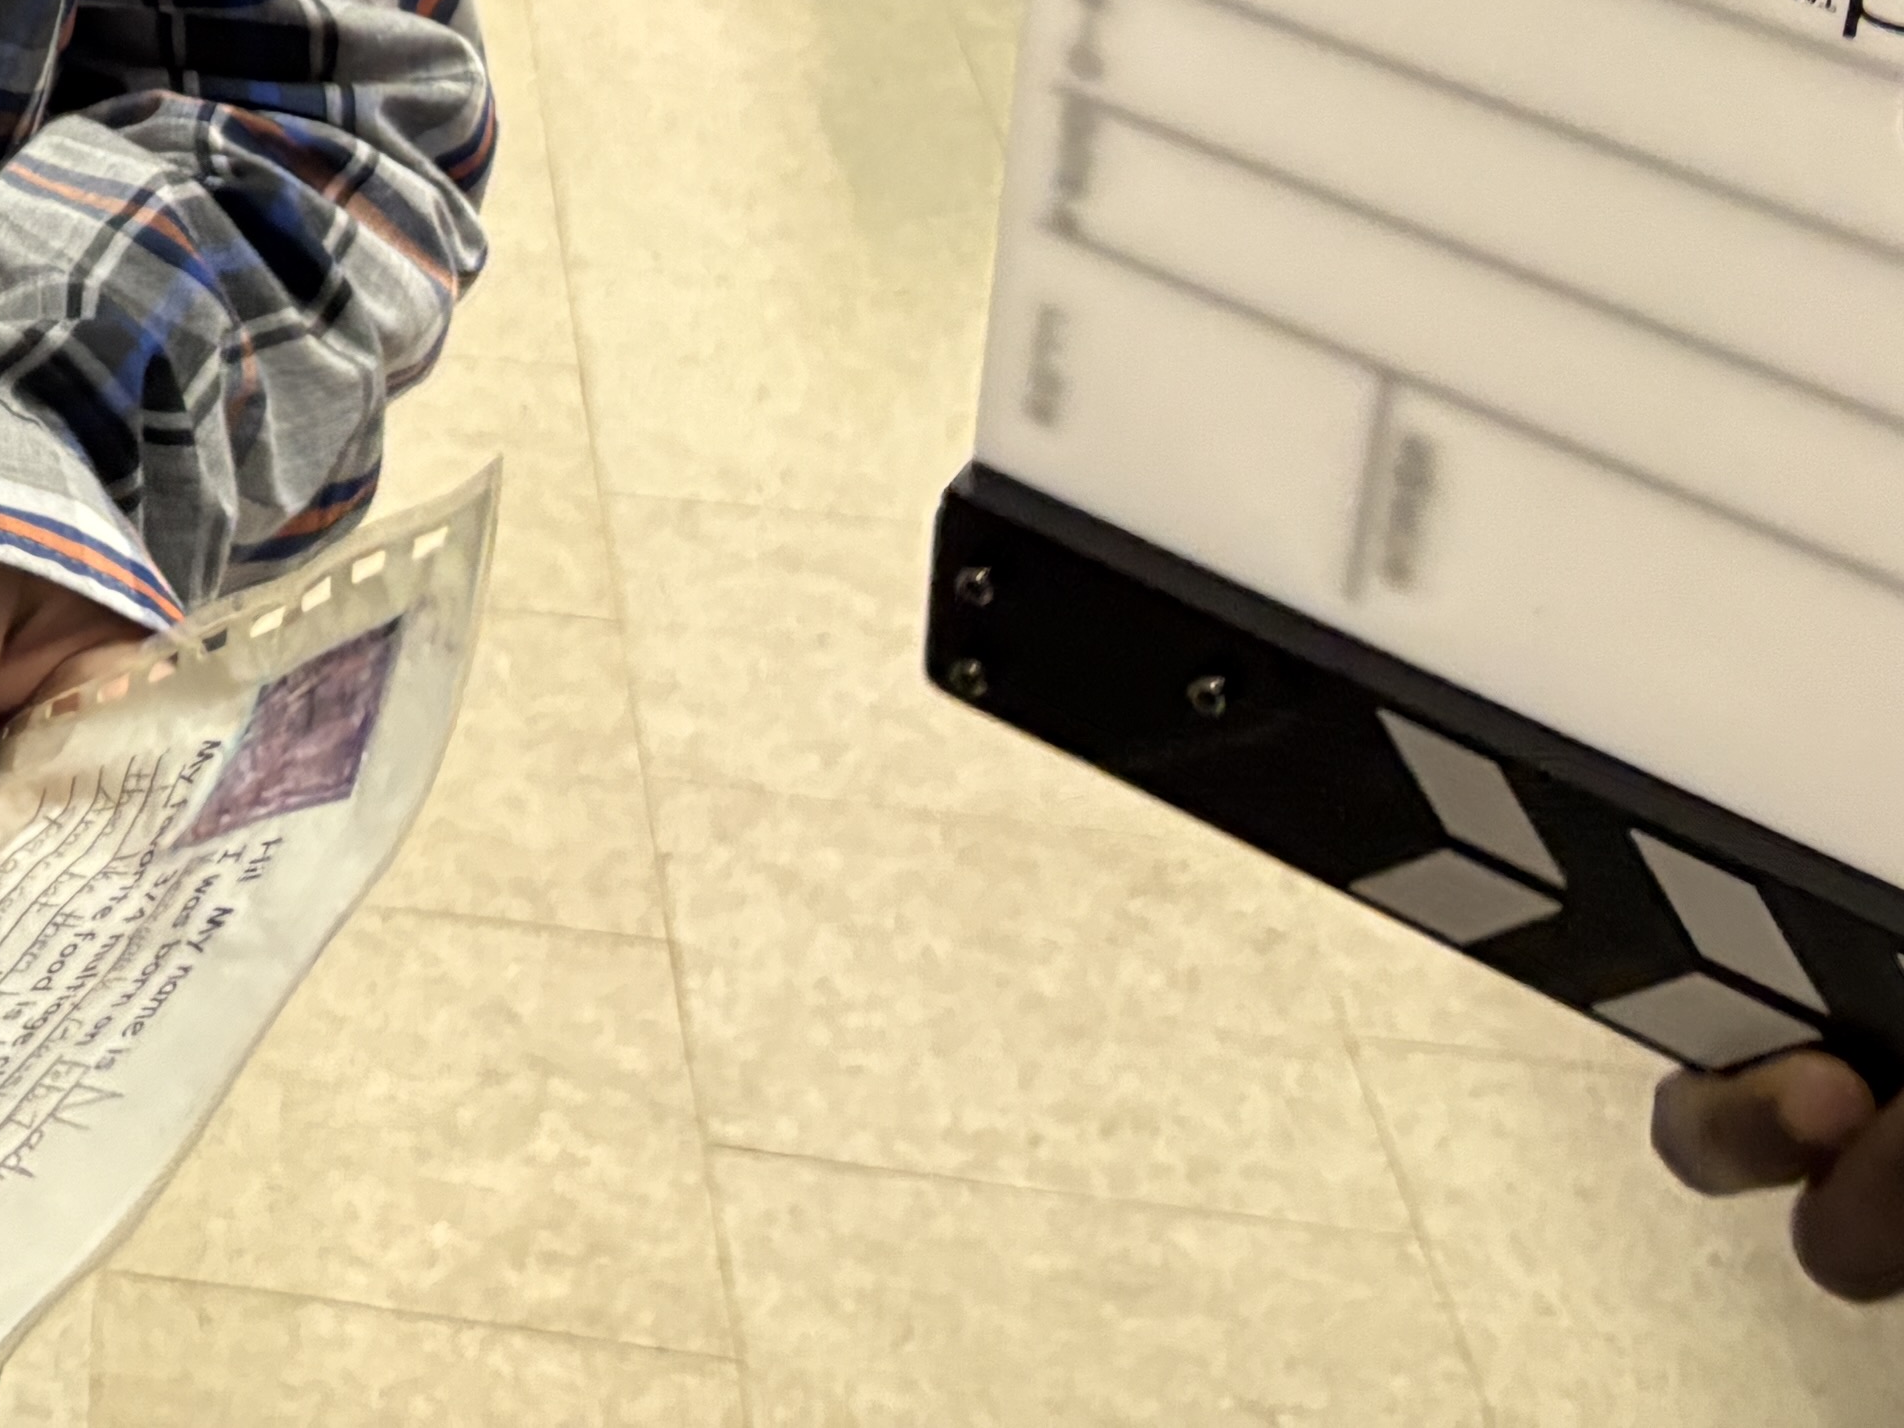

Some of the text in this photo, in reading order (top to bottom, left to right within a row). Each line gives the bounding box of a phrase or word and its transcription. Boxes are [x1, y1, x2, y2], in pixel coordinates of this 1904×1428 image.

[179, 740, 222, 784] My
[91, 799, 188, 927] favorite
[29, 931, 97, 991] food
[73, 847, 247, 1045] I was born on
[185, 908, 234, 954] My
[2, 1002, 36, 1021] is
[11, 932, 122, 1049] multiage
[119, 964, 193, 1038] name
[92, 1048, 132, 1073] is
